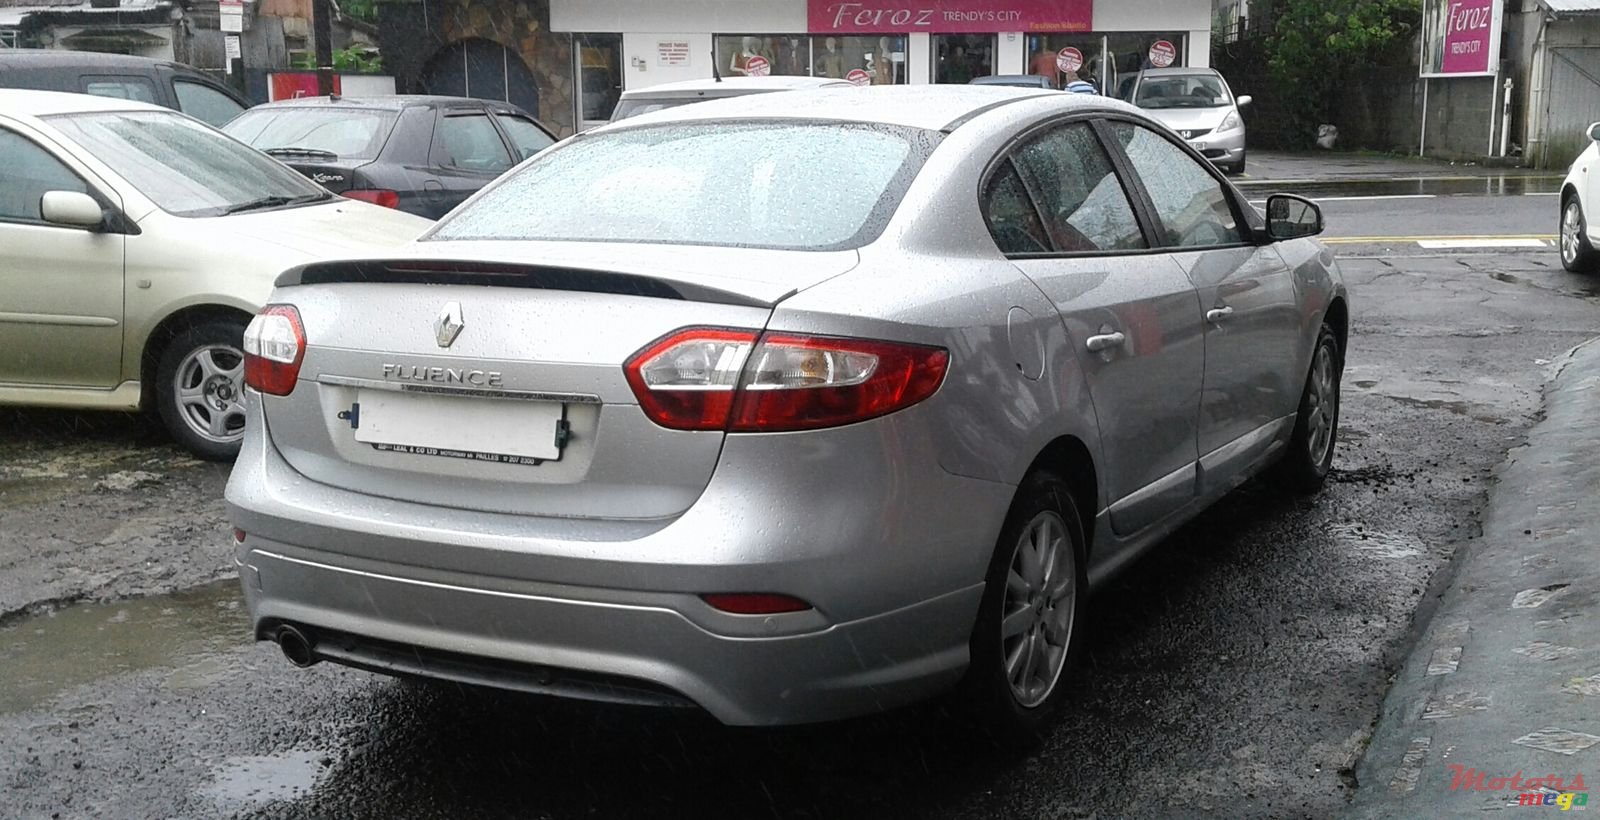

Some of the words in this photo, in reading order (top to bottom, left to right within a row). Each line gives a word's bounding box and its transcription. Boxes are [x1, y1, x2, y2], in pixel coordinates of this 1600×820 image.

[827, 3, 934, 28] Feroz
[943, 11, 995, 21] TRENDY'S
[997, 11, 1022, 21] CITY
[1447, 3, 1490, 35] Feroz
[1471, 40, 1481, 53] CITY
[382, 363, 504, 388] FLUENCE
[393, 444, 408, 453] LEAL
